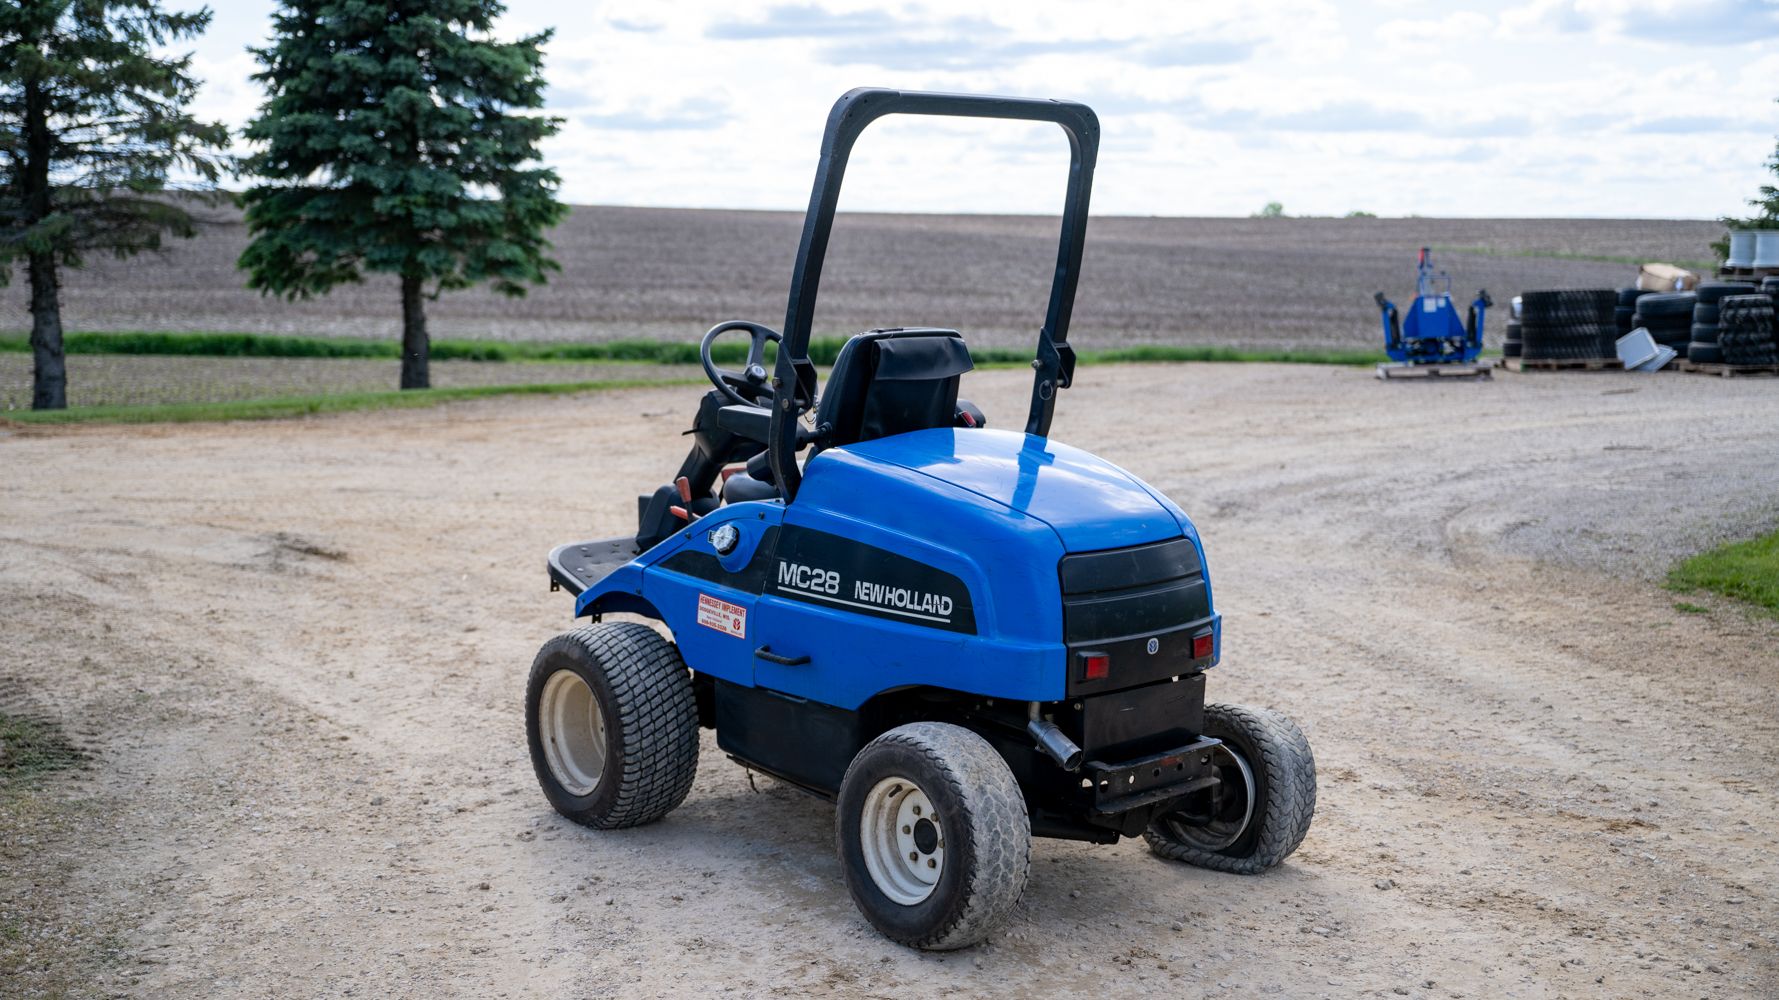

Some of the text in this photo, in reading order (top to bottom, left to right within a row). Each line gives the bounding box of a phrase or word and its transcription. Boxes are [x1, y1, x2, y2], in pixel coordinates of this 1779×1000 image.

[778, 561, 840, 595] MC28
[885, 586, 953, 616] HOLLAND
[722, 603, 745, 617] IMPLEMENT
